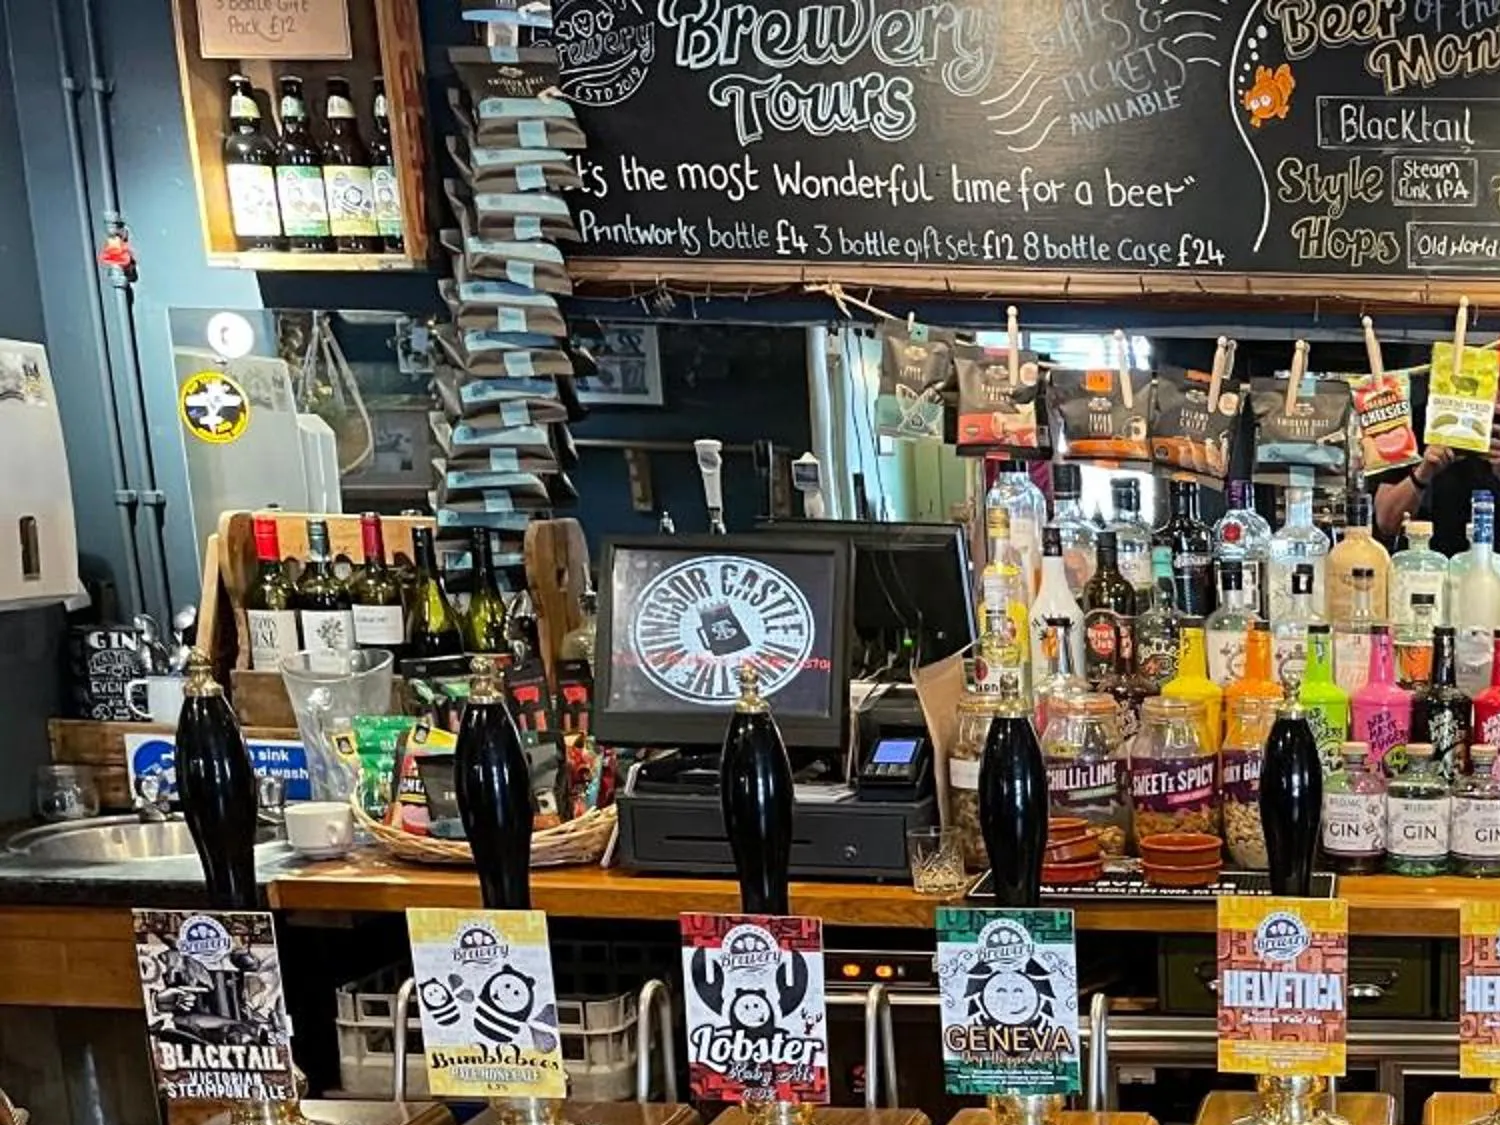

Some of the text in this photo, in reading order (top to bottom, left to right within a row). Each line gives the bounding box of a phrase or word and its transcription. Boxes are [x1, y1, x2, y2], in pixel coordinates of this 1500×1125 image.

[228, 16, 298, 35] Pack £12
[1271, 0, 1408, 60] Beer
[657, 0, 996, 97] Brewery
[575, 66, 642, 101] ESTD 2019
[709, 72, 918, 147] Tours
[1069, 86, 1182, 136] AVAILABLE
[620, 153, 1093, 213] the most Wonderful time for a
[1277, 155, 1460, 220] Style Steam
[1398, 179, 1471, 201] Punk IPA
[579, 209, 702, 256] Printworks
[707, 215, 771, 250] bottle
[775, 218, 809, 256] £4
[813, 224, 833, 255] 3
[839, 226, 901, 257] bottle
[903, 225, 941, 263] gift
[981, 229, 1019, 261] £12
[1022, 230, 1040, 262] 8
[1042, 233, 1111, 262] bottle
[1176, 233, 1225, 267] £24
[1290, 215, 1400, 268] Hops
[1418, 234, 1446, 257] Old
[720, 562, 805, 637] CASTLE
[258, 749, 289, 762] sink
[277, 767, 309, 780] wash
[1177, 762, 1215, 793] SPICY
[1328, 821, 1360, 838] GIN
[1402, 823, 1437, 840] GIN
[720, 951, 782, 969] Brewery
[1223, 969, 1344, 1011] HELVETICA
[690, 1022, 825, 1074] Lobster
[944, 1024, 1075, 1053] GENEVA
[158, 1042, 286, 1071] BLACKTAIL
[431, 1042, 560, 1070] Bumblebees
[188, 1071, 263, 1086] VICTORIAN
[258, 1085, 287, 1100] ALE
